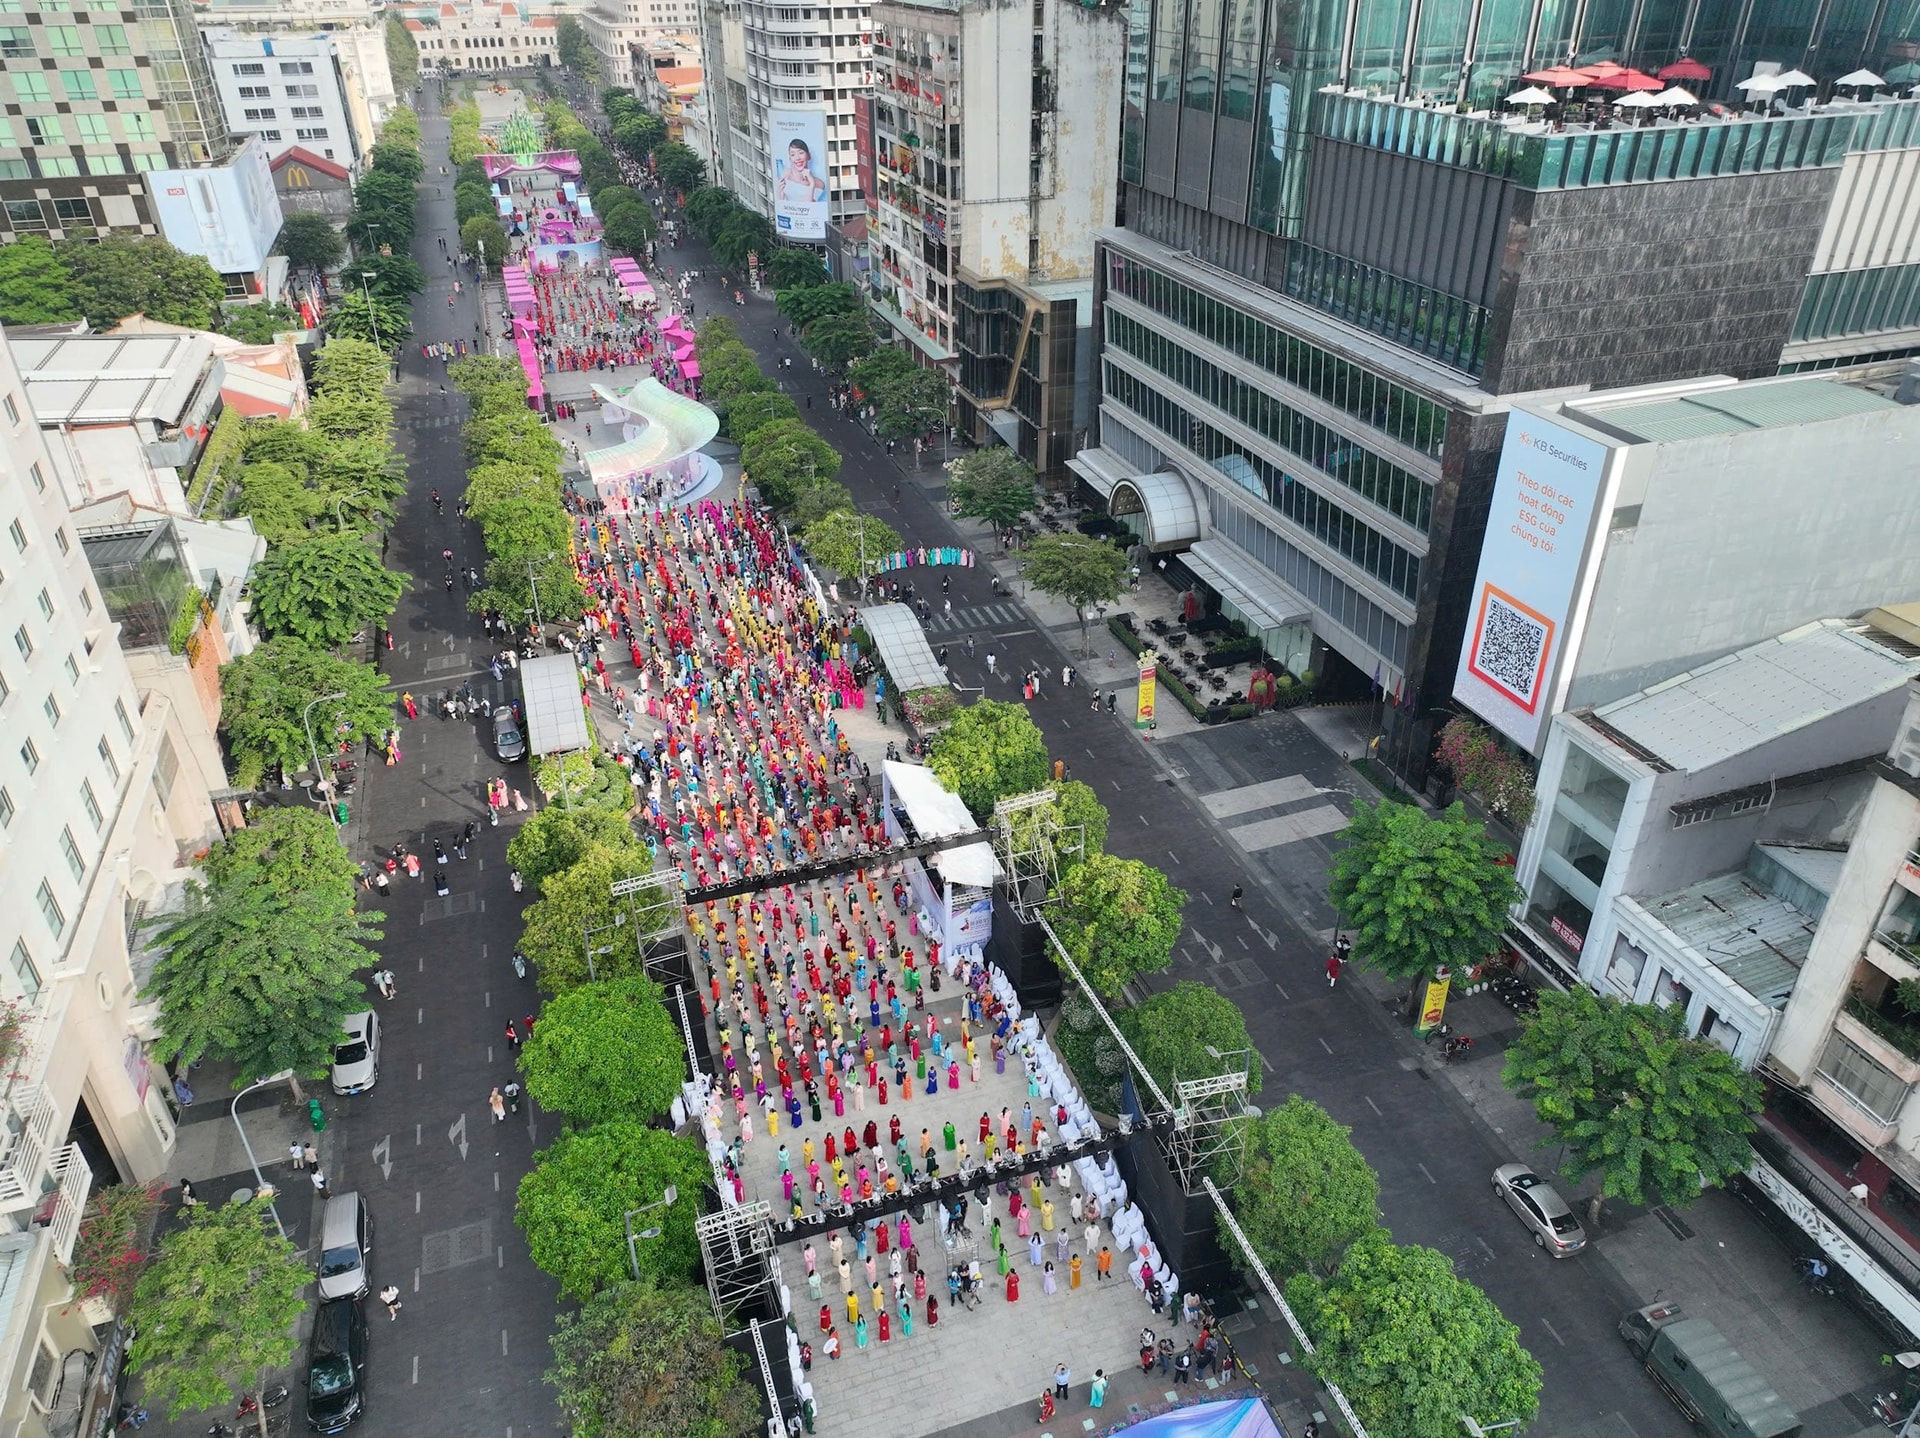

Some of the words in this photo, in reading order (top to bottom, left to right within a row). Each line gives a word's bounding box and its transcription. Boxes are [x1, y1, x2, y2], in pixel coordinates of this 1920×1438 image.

[1533, 438, 1549, 452] KB
[1549, 444, 1588, 471] Securities
[1518, 471, 1540, 491] Theo
[1541, 484, 1556, 500] dõi
[1558, 493, 1575, 509] các
[1519, 509, 1537, 527] ESG
